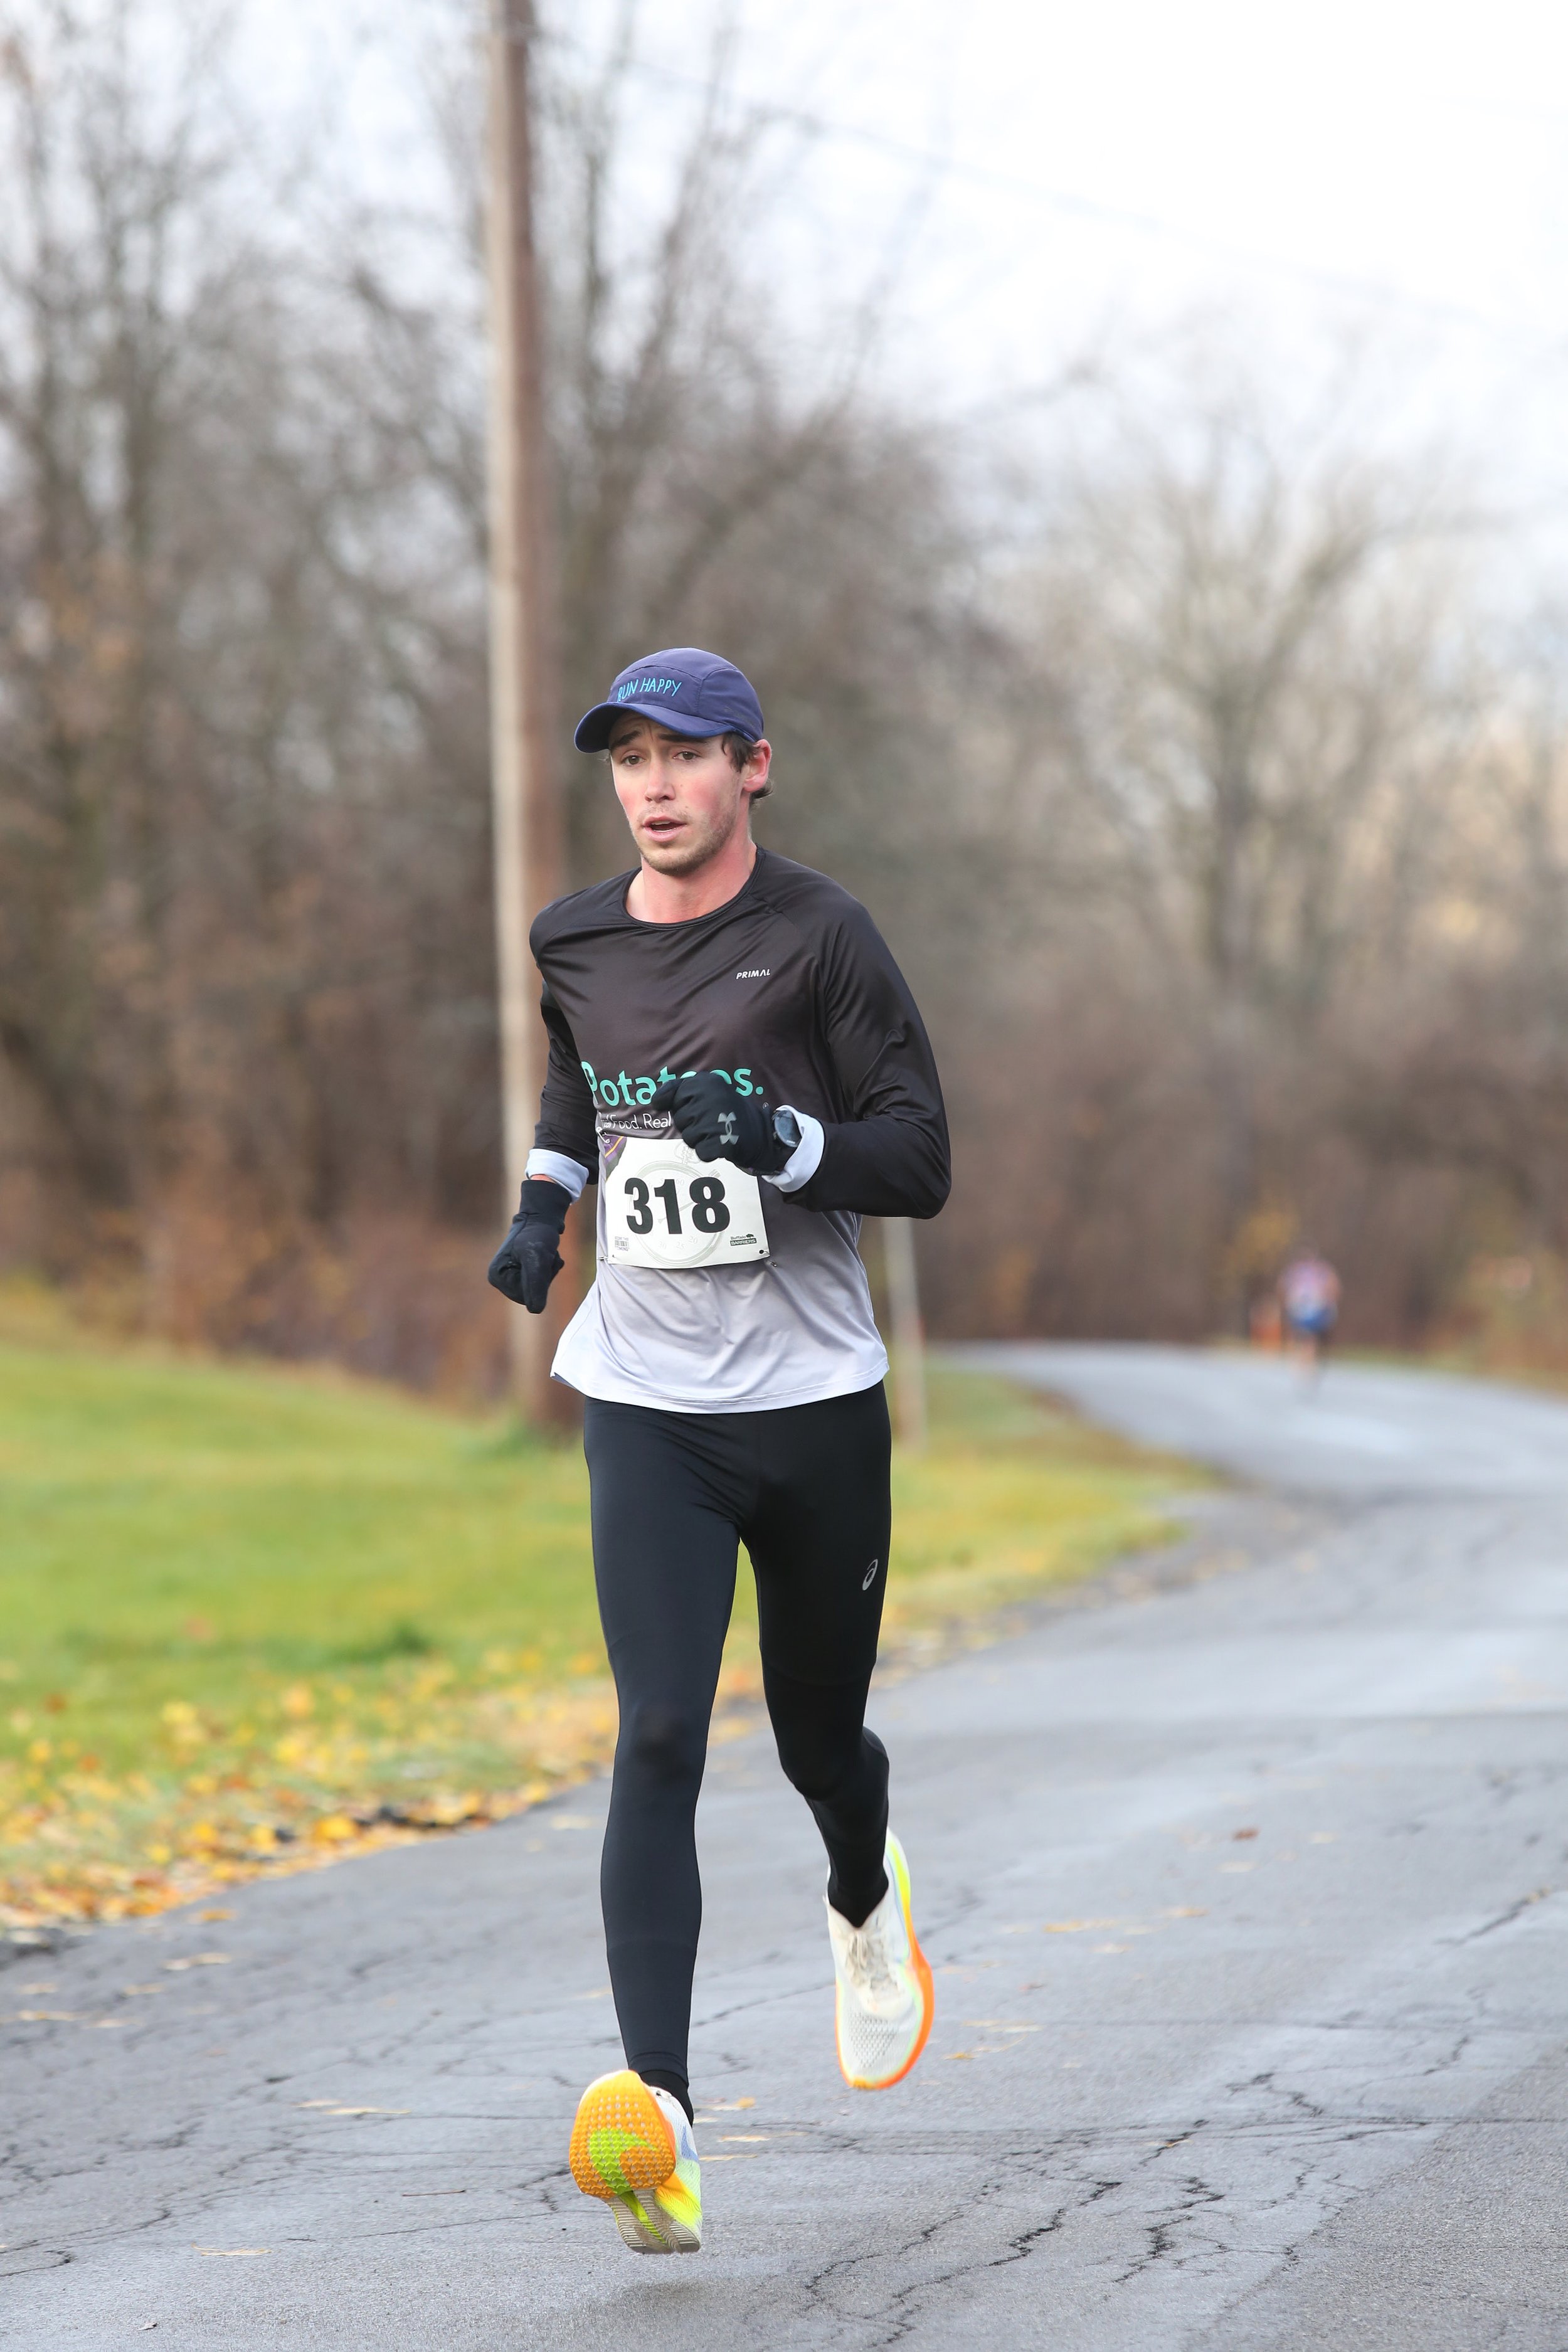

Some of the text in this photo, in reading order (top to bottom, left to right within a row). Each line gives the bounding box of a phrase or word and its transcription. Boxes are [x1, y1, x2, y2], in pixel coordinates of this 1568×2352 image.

[617, 677, 682, 702] RUN HAPPY
[736, 968, 771, 980] PRIMAL
[581, 1061, 764, 1107] Potats.
[610, 1114, 642, 1130] Food.
[643, 1111, 672, 1129] Real
[624, 1176, 731, 1235] 318
